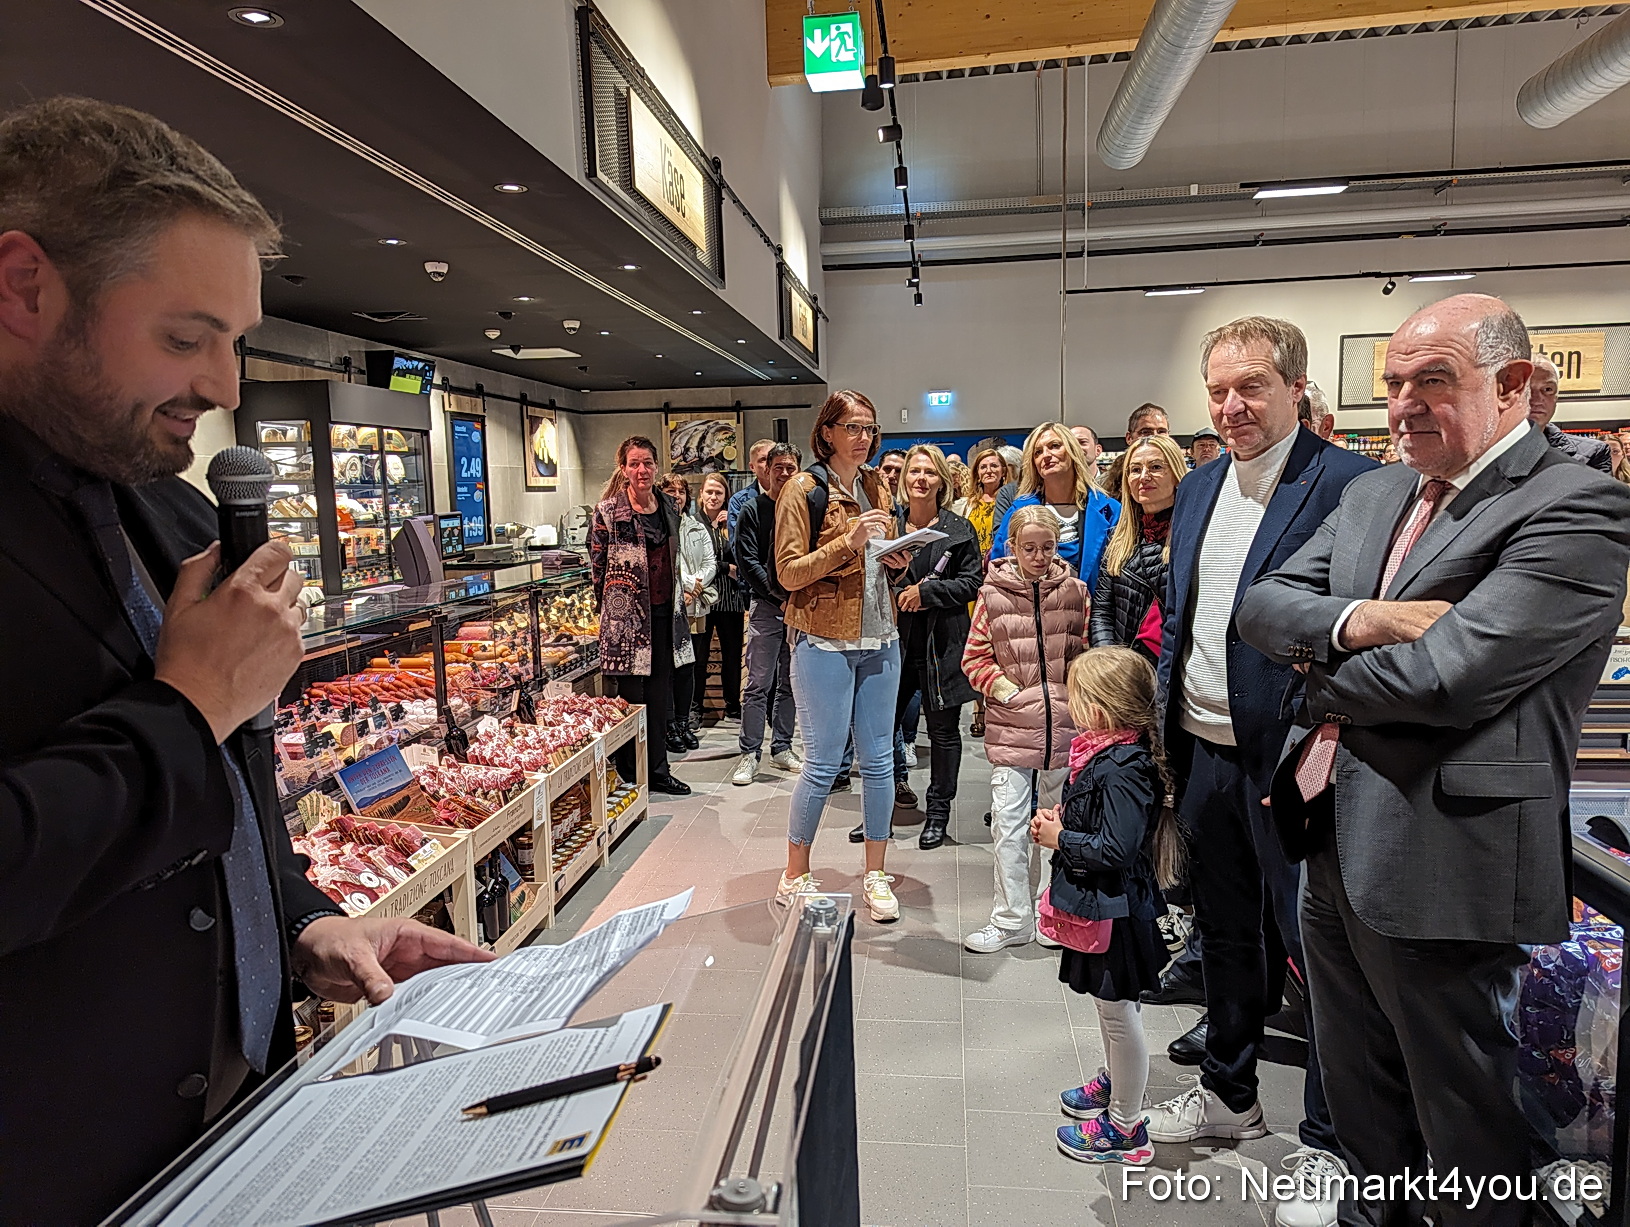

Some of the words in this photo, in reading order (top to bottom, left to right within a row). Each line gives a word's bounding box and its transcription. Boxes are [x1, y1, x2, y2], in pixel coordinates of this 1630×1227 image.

[659, 137, 686, 219] Käse
[461, 456, 482, 478] 2.49
[390, 877, 428, 918] TRADIZIONE
[429, 857, 455, 889] TOSCANA
